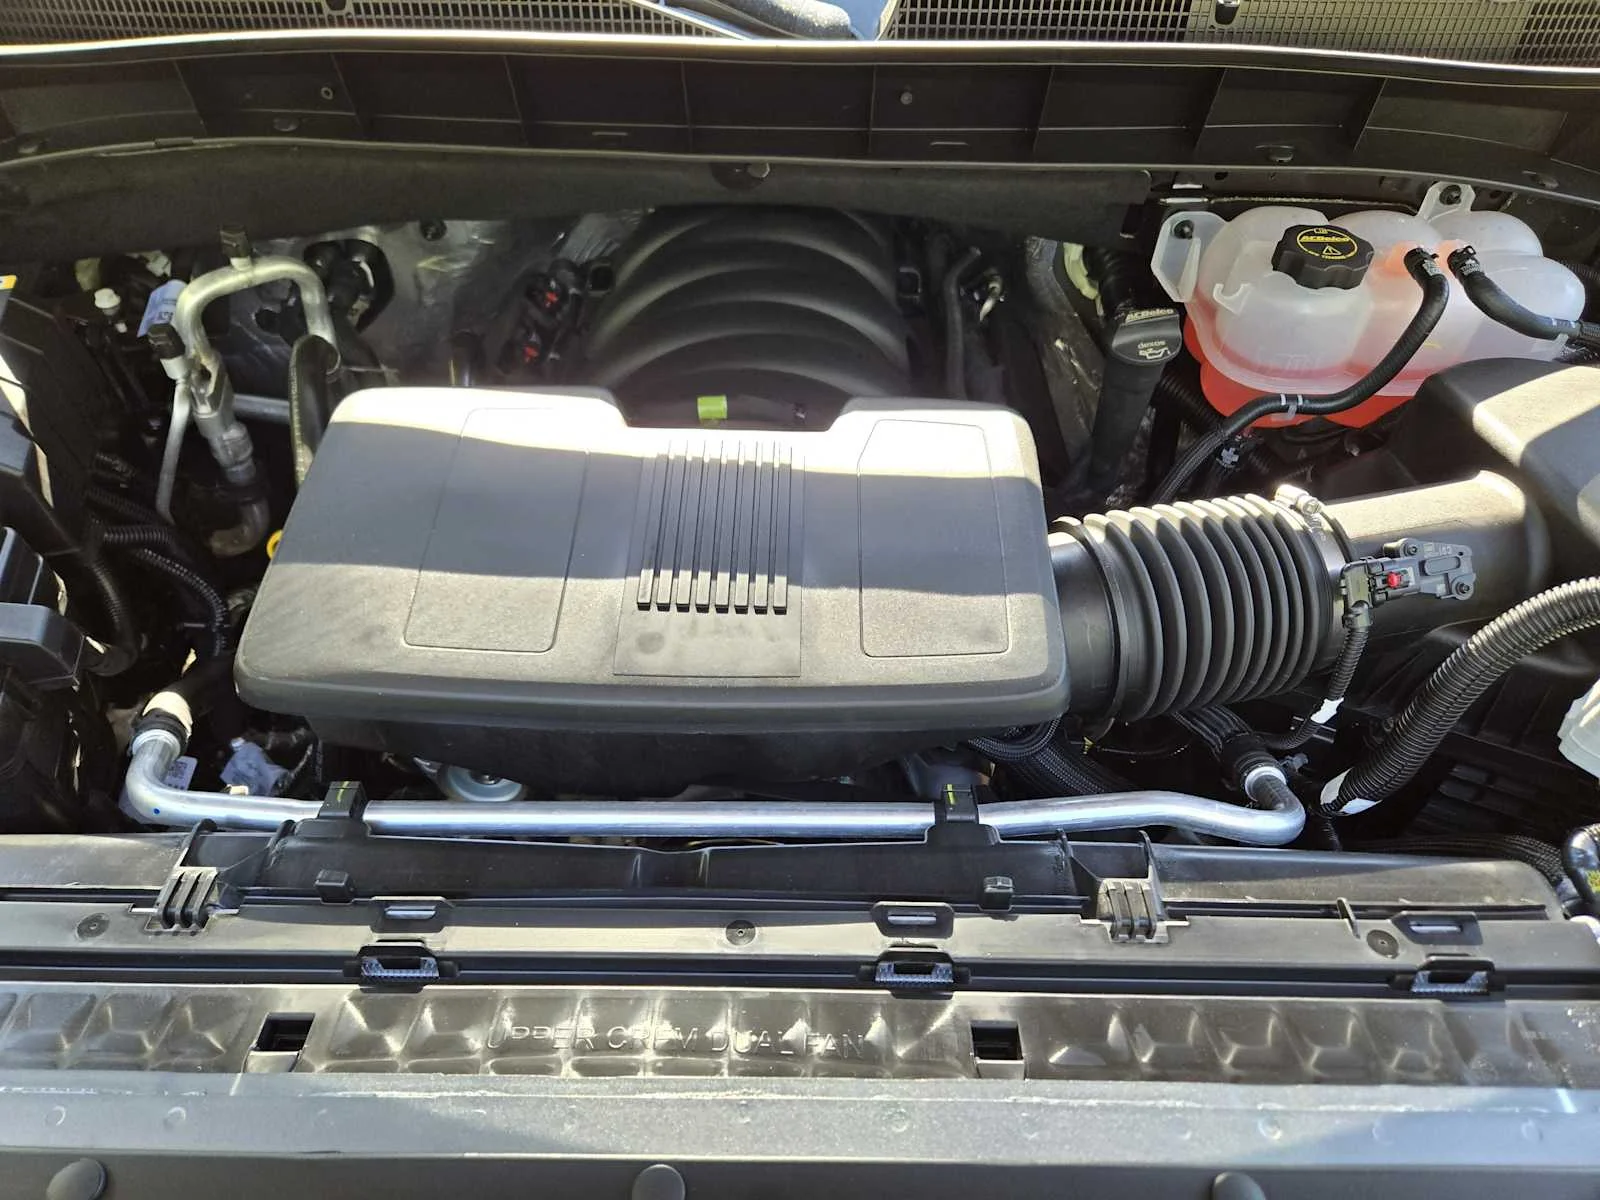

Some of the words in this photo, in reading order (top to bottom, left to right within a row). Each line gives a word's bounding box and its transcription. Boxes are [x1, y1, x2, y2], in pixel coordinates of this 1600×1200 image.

[1125, 309, 1174, 324] ACDelco
[487, 1025, 594, 1049] UPPER
[711, 1030, 794, 1055] DUAL
[804, 1031, 865, 1058] FAN
